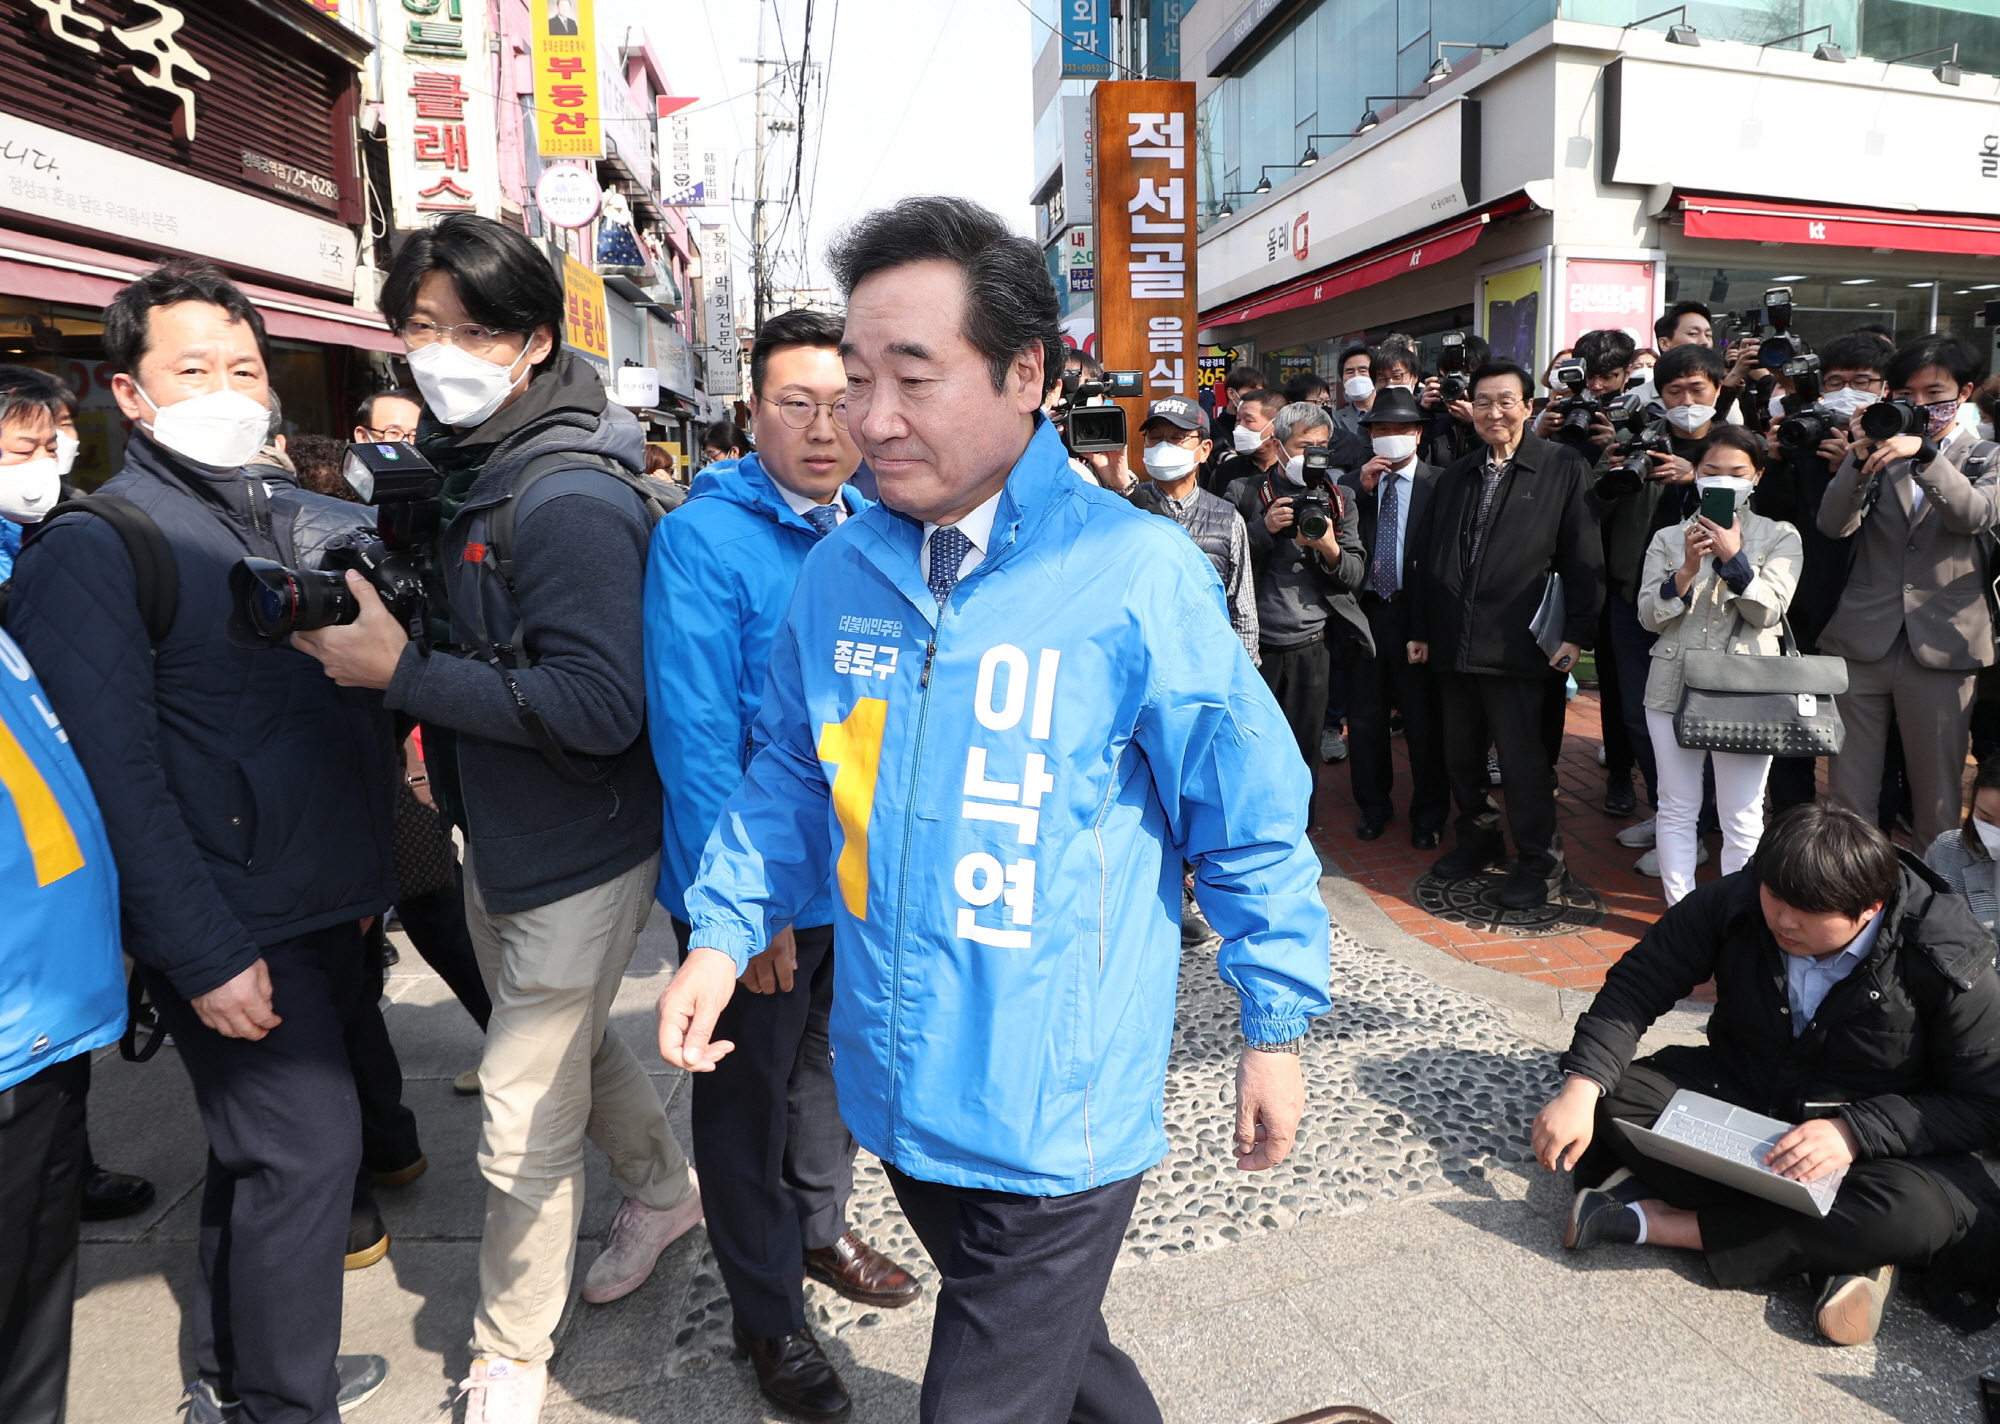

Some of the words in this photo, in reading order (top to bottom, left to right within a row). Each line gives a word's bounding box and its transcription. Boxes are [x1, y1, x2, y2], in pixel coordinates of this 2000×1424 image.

[1073, 0, 1100, 55] 외과
[1064, 63, 1109, 73] 733-0052/3
[547, 57, 588, 135] 부동산
[0, 141, 61, 181] 니다.
[545, 139, 594, 152] 733-3388
[8, 175, 48, 201] 정성과
[52, 186, 78, 210] 혼을
[78, 194, 103, 217] 담은
[1128, 112, 1186, 299] 적선골
[1267, 221, 1289, 262] 올레
[1809, 222, 1826, 240] kt
[1410, 249, 1422, 267] kt
[1314, 285, 1323, 300] kt
[568, 290, 606, 352] 부동산
[1148, 316, 1184, 396] 음식
[838, 615, 904, 638] 더불어민주당
[833, 640, 900, 681] 종로구
[817, 697, 889, 921] 1
[954, 643, 1062, 949] 이낙연
